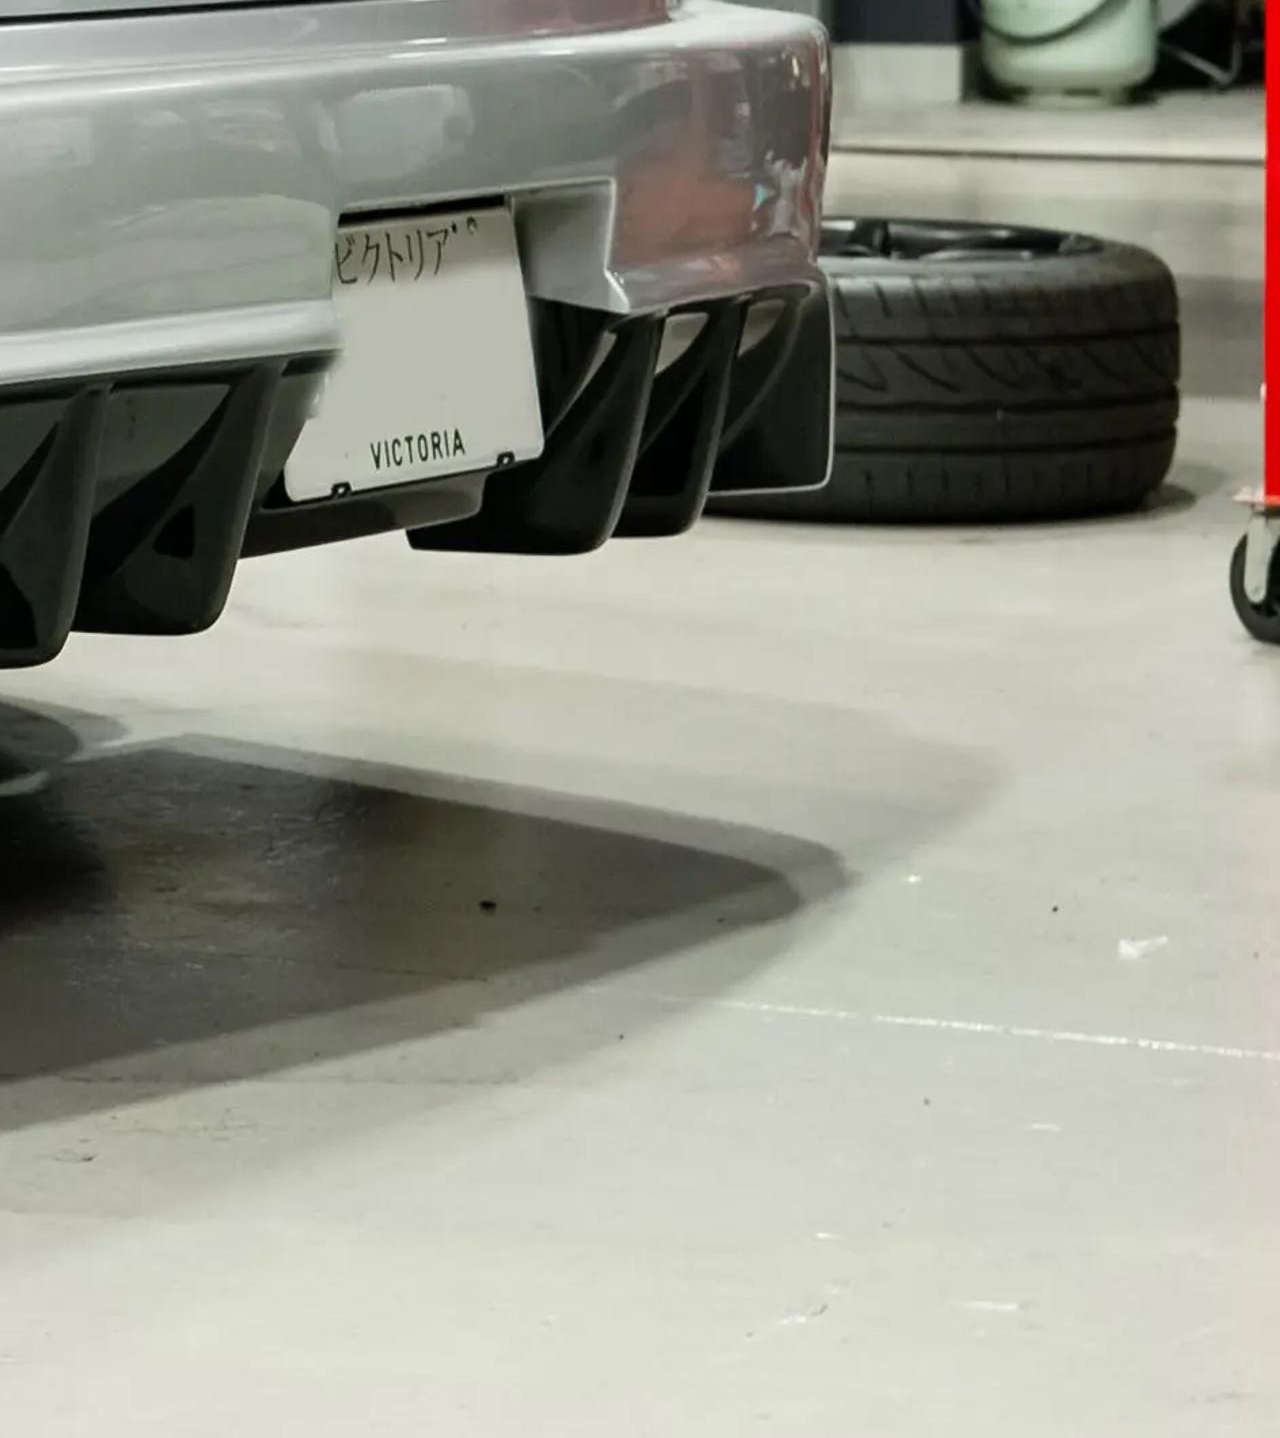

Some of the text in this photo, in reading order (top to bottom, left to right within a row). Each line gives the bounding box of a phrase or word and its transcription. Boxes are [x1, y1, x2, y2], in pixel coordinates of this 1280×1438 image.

[334, 228, 450, 285] ビクトリア
[370, 428, 466, 470] VICTORIA
